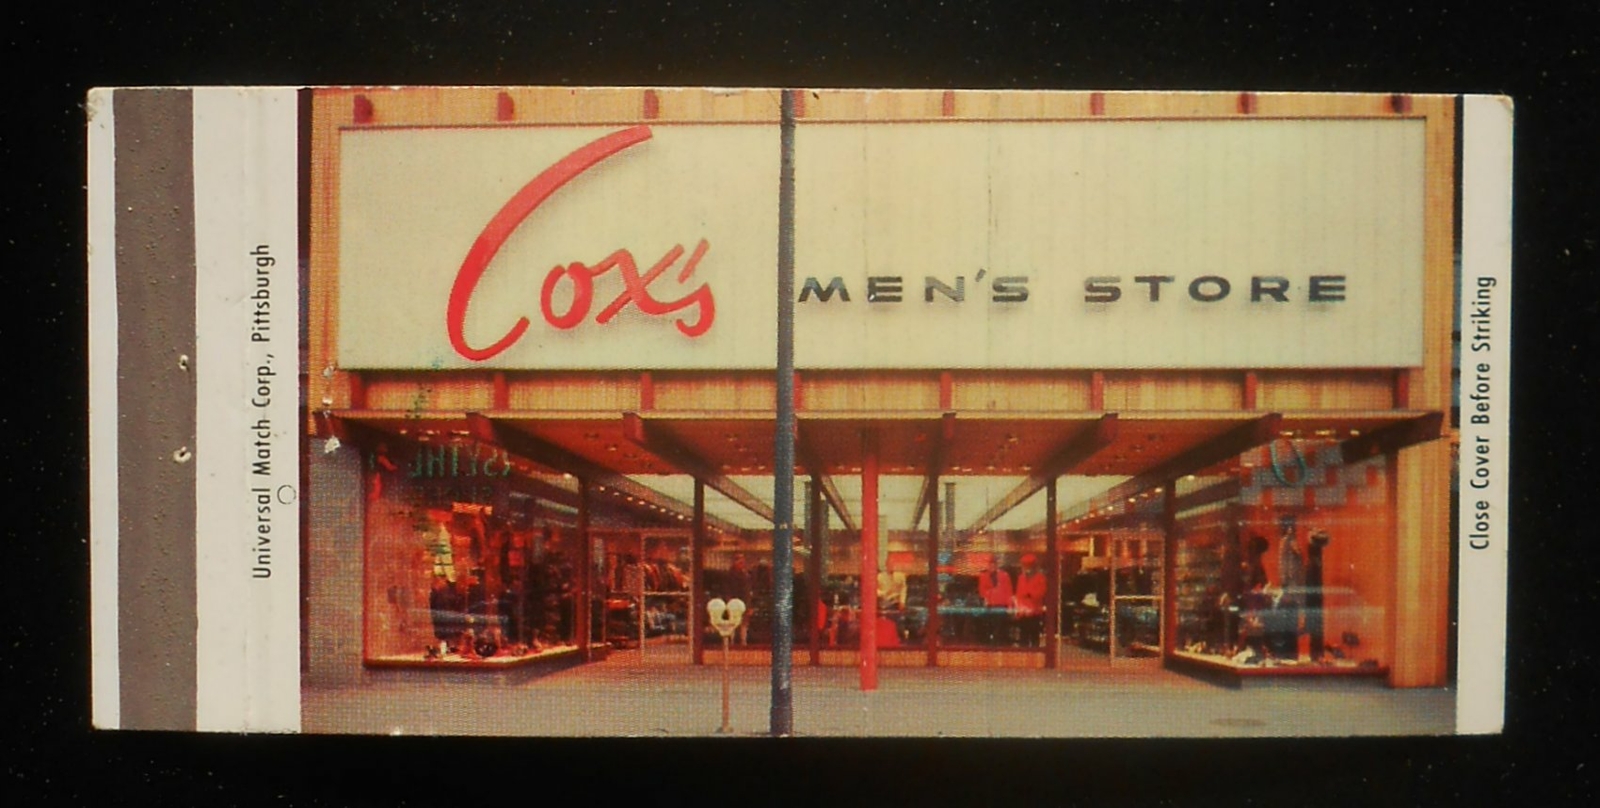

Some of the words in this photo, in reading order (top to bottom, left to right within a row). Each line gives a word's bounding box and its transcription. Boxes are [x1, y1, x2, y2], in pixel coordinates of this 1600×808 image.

[446, 124, 715, 361] Cox's
[250, 244, 275, 342] Pittsburgh
[797, 268, 1029, 303] MEN'S
[1083, 274, 1347, 303] STORE
[1471, 276, 1496, 352] Striking
[251, 353, 276, 408] Corp.,
[1470, 362, 1491, 425] Before
[251, 419, 271, 476] Match
[1469, 435, 1490, 489] Cover
[251, 488, 272, 579] Universal
[1469, 500, 1490, 550] Close
